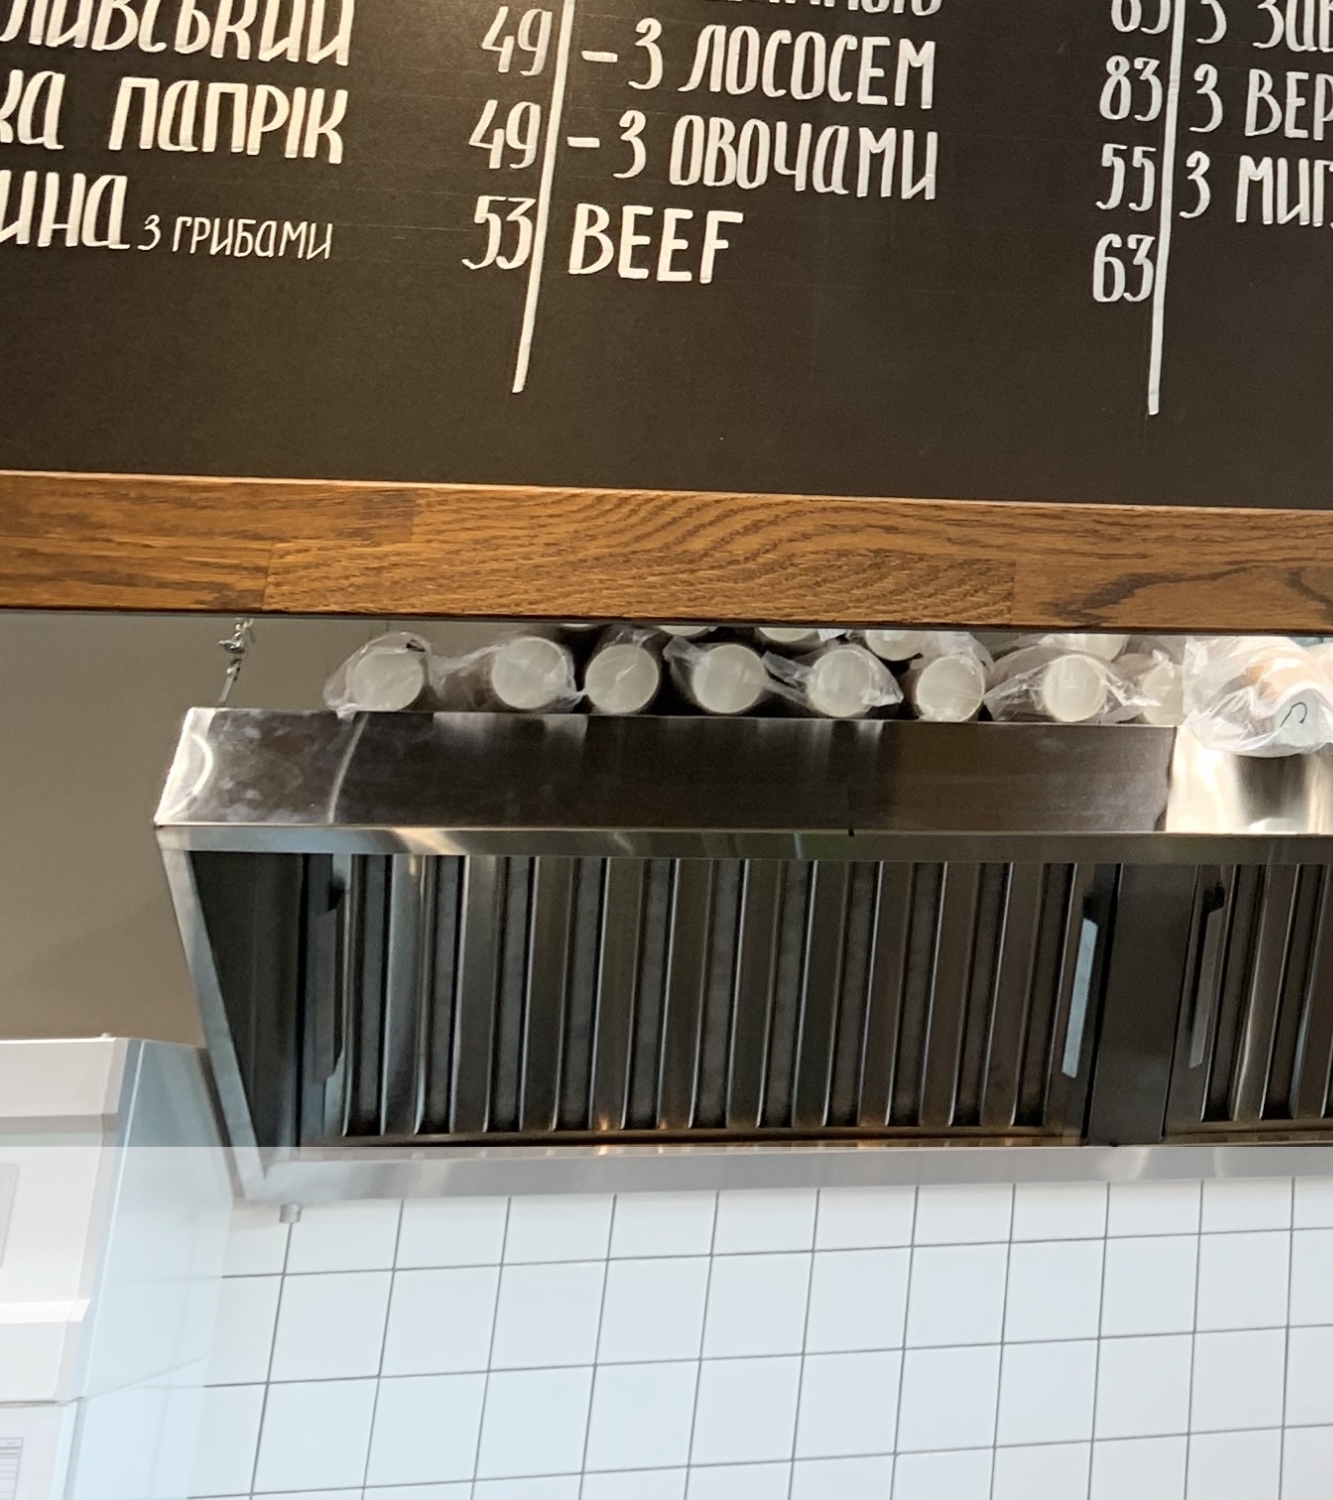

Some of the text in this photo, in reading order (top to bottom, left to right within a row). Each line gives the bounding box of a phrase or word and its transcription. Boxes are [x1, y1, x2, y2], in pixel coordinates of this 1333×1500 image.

[481, 6, 553, 76] 49
[678, 23, 1163, 122] ЛОСОСЕМ 83
[108, 76, 541, 169] ПАПРІК 49
[668, 114, 1158, 212] ОВОЧАМИ 55
[171, 195, 537, 270] ГРИБАМИ 53
[568, 202, 1156, 303] BEEF 63
